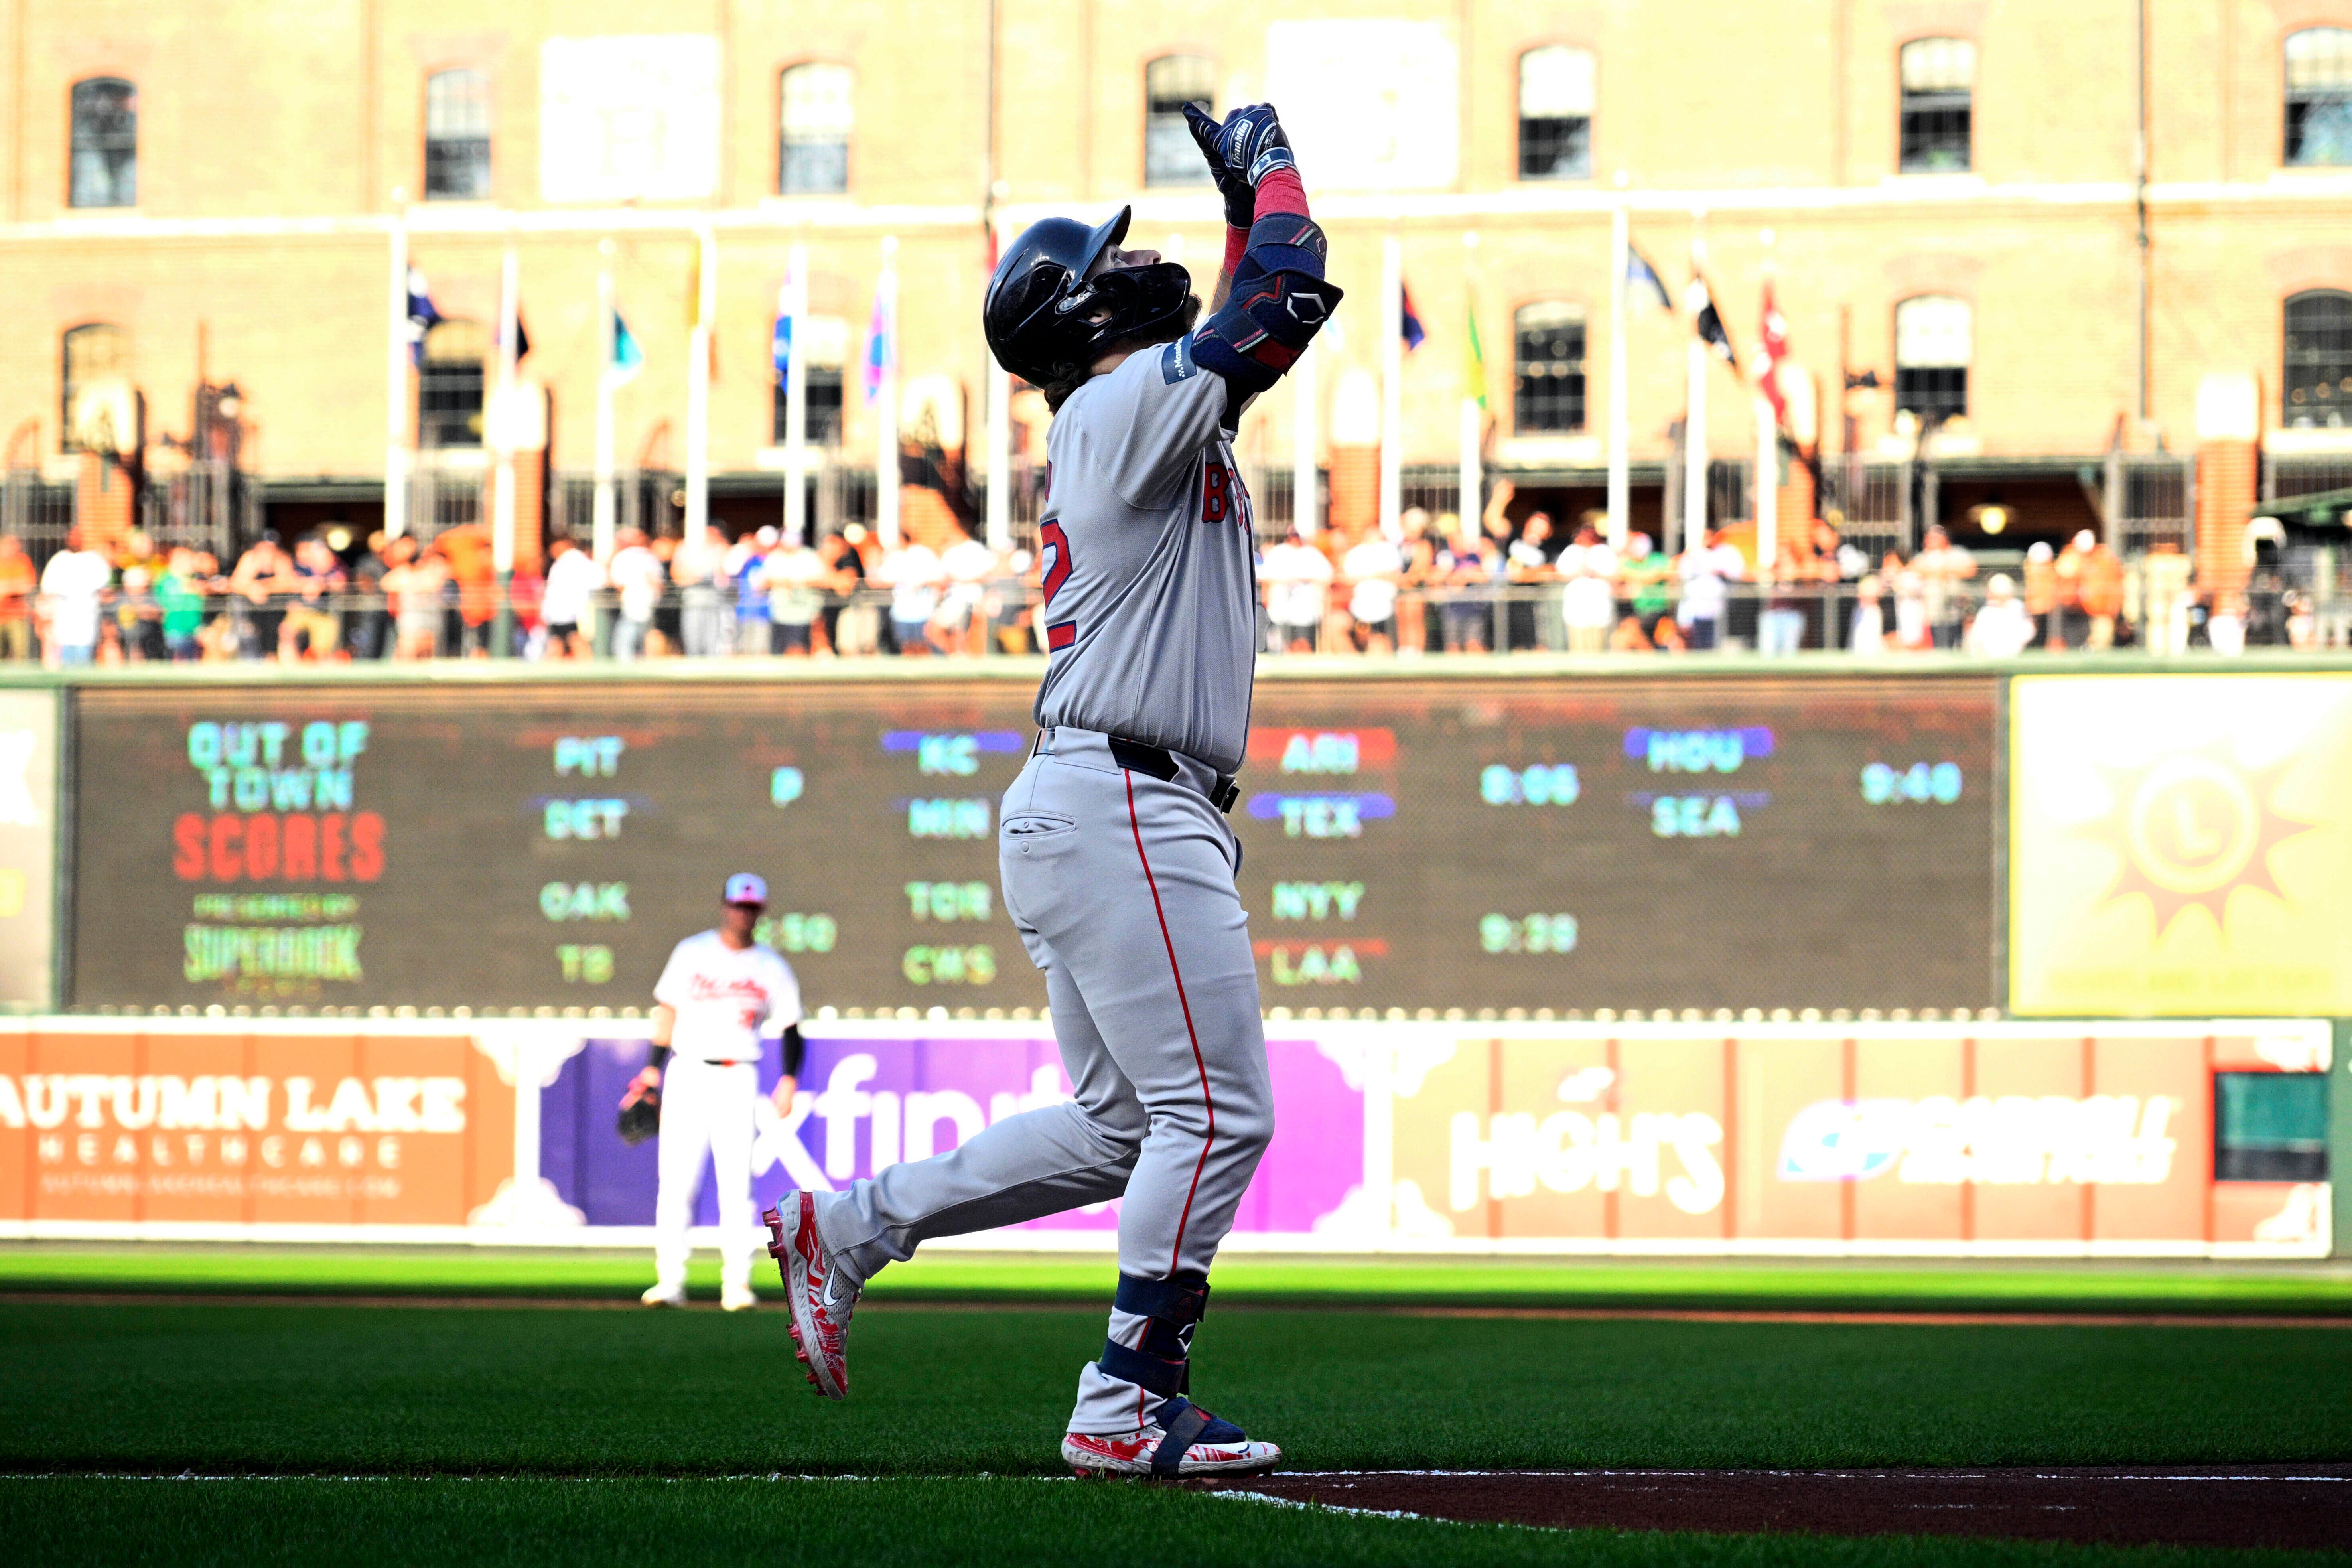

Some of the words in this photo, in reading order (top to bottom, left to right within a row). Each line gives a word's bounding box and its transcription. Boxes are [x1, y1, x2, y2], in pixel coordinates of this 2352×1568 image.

[187, 721, 290, 770] OUT
[301, 720, 370, 768] OF
[554, 736, 626, 777] PIT
[1647, 731, 1744, 773] HOU
[203, 766, 353, 813] TOWN
[1278, 797, 1362, 838] TEX
[1651, 796, 1742, 838] SEA
[173, 811, 384, 882] SCORES
[539, 881, 632, 922] OAK
[1271, 881, 1366, 921] NYY
[1271, 944, 1362, 986] LAA
[283, 1076, 467, 1133] LAKE
